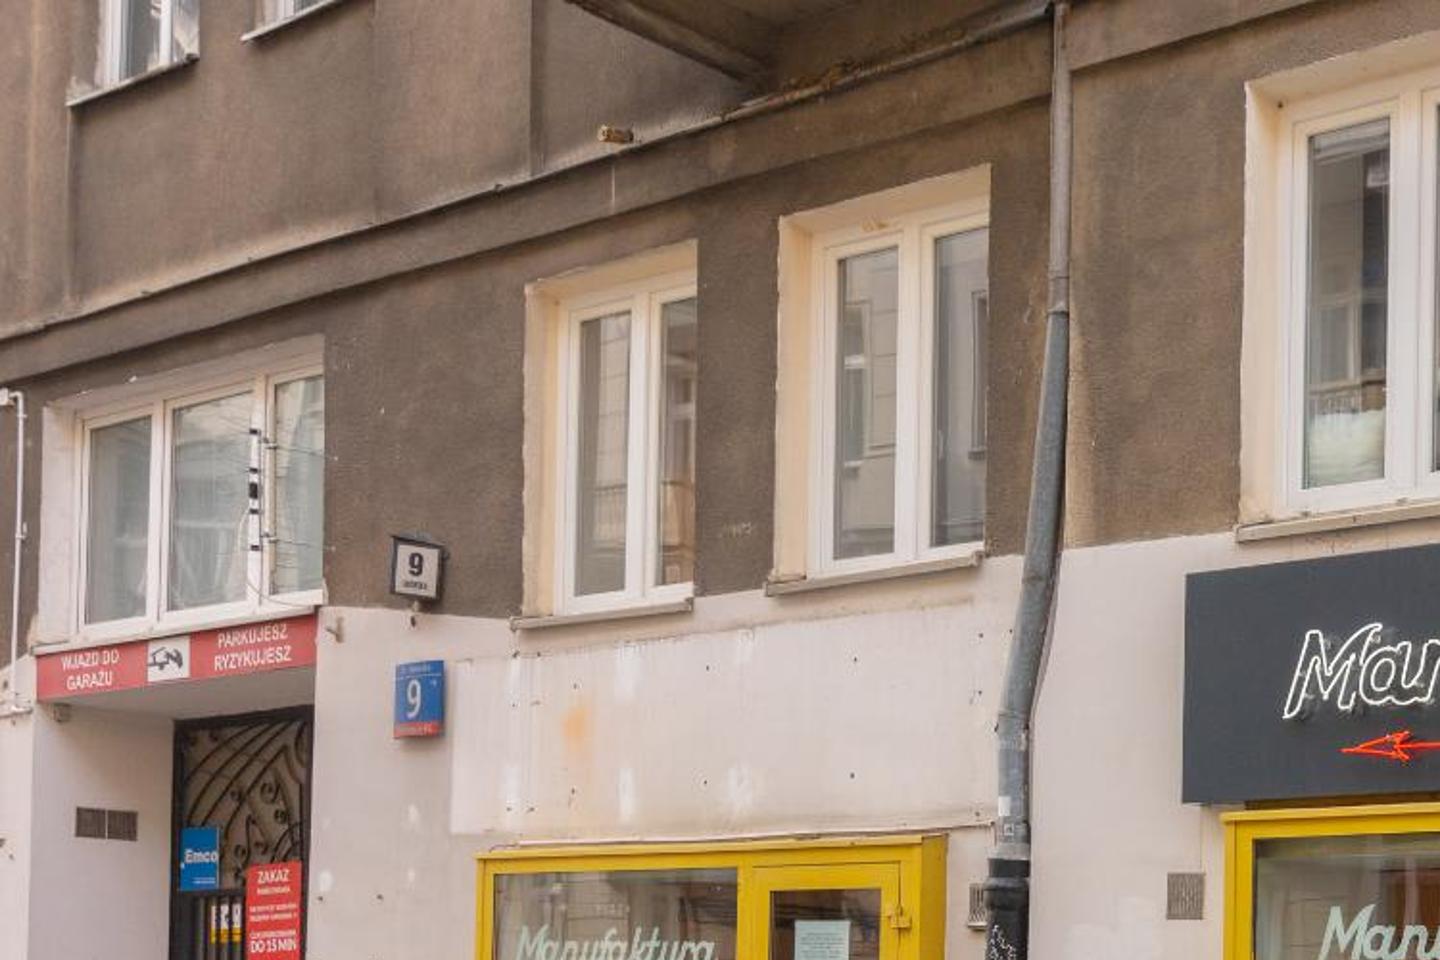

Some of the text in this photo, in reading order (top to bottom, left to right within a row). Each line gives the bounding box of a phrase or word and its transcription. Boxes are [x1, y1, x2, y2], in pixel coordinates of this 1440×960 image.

[408, 552, 424, 577] 9
[217, 623, 289, 649] PARKUJESZ
[60, 648, 120, 671] WJAZD DO
[214, 644, 292, 672] RYZYKUJESZ
[406, 678, 422, 720] 9
[257, 868, 291, 884] ZAKAZ
[250, 939, 265, 954] DO
[277, 937, 297, 952] MIN
